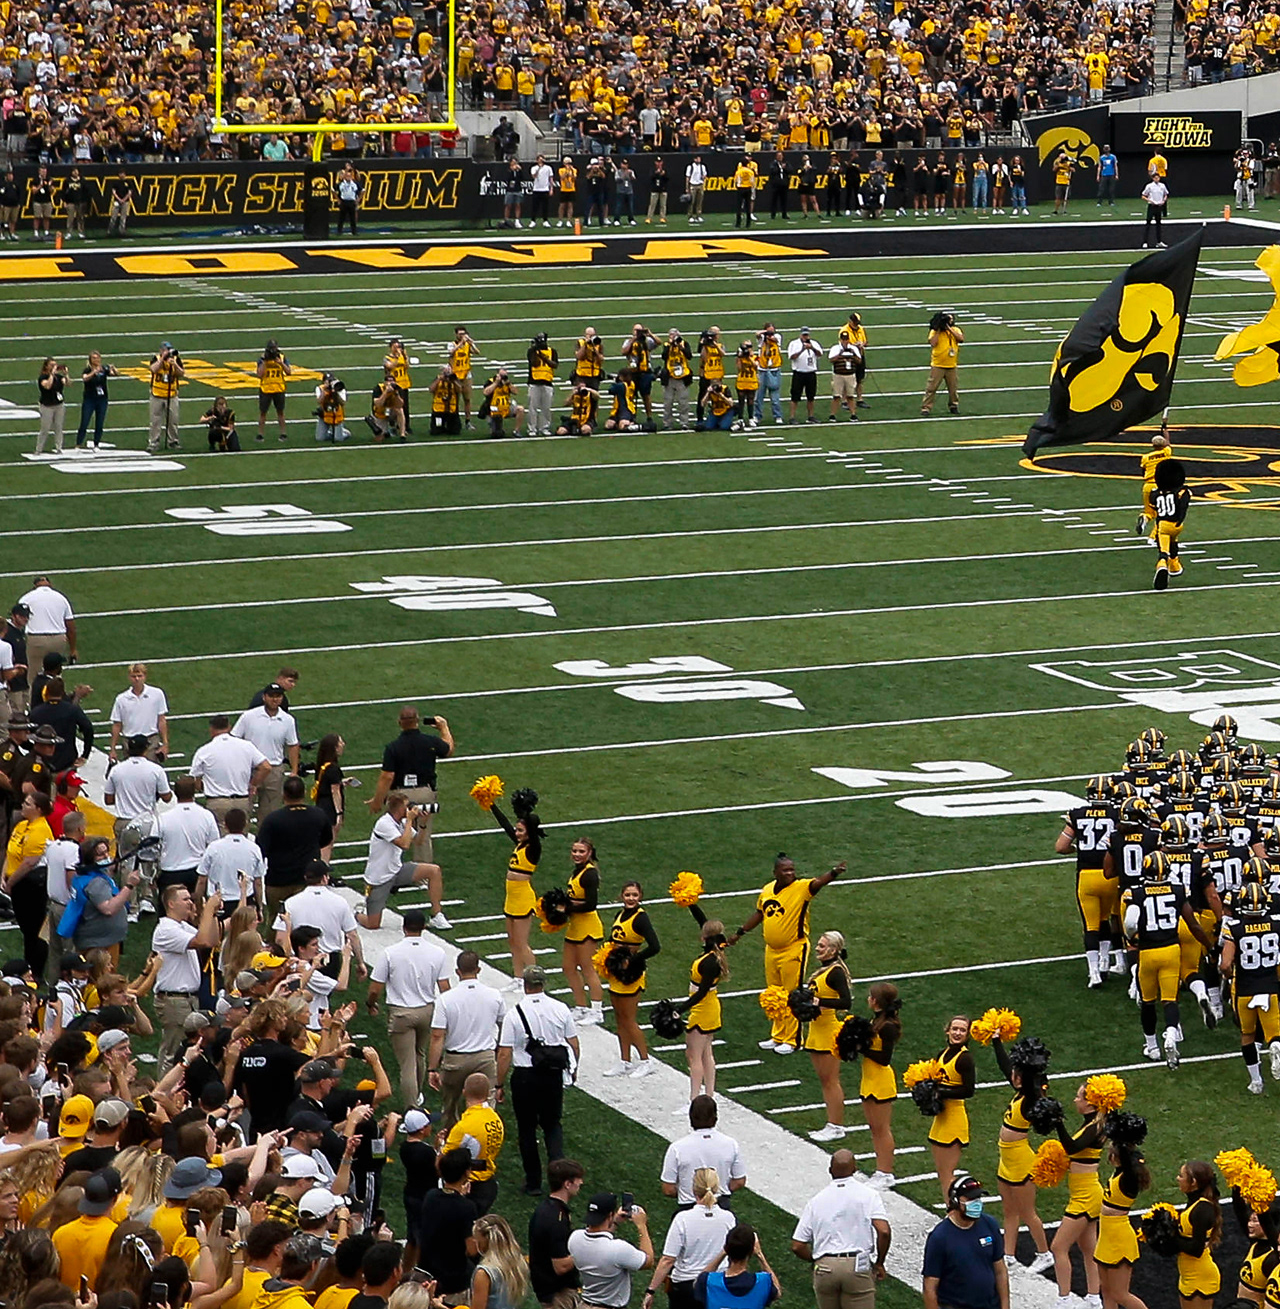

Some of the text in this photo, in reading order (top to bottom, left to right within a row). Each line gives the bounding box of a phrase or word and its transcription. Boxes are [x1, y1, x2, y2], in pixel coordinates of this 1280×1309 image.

[1143, 117, 1192, 132] FIGHT
[1164, 130, 1213, 147] IOWA
[0, 238, 829, 278] IOWA
[164, 504, 354, 536] 50
[1156, 494, 1175, 516] 00
[350, 574, 546, 611] 40
[553, 655, 796, 703] 30
[810, 760, 1090, 818] 20
[1076, 818, 1114, 851] 32
[1123, 844, 1143, 876] 0
[1144, 894, 1177, 931] 15
[1239, 934, 1280, 969] 89
